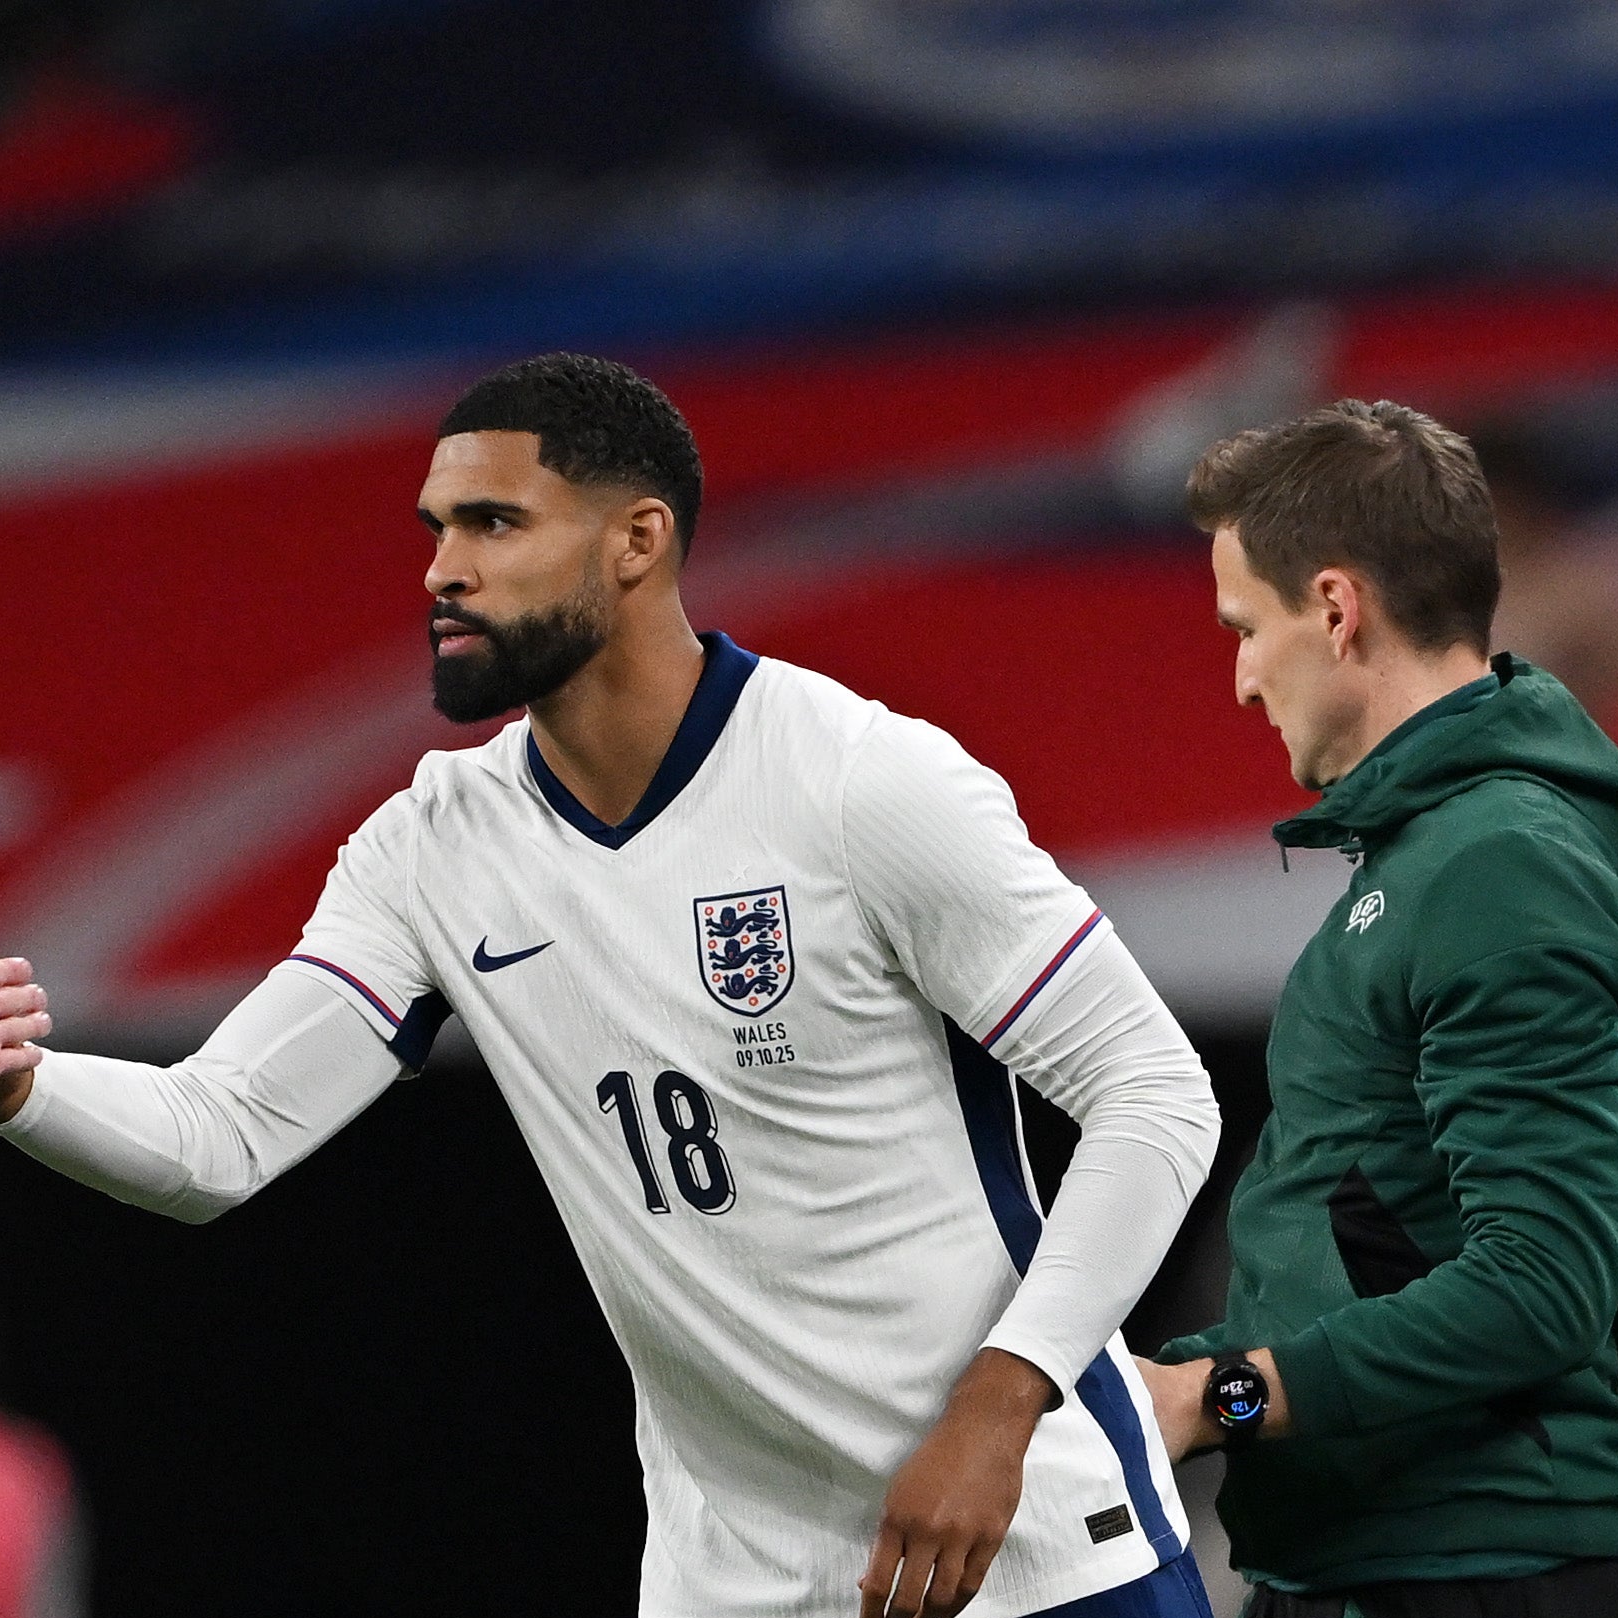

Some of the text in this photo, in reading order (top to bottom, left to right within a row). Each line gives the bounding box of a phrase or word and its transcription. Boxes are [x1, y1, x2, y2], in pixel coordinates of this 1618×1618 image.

[733, 1022, 787, 1045] WALES
[736, 1044, 795, 1067] 09.10.25
[596, 1070, 736, 1215] 18
